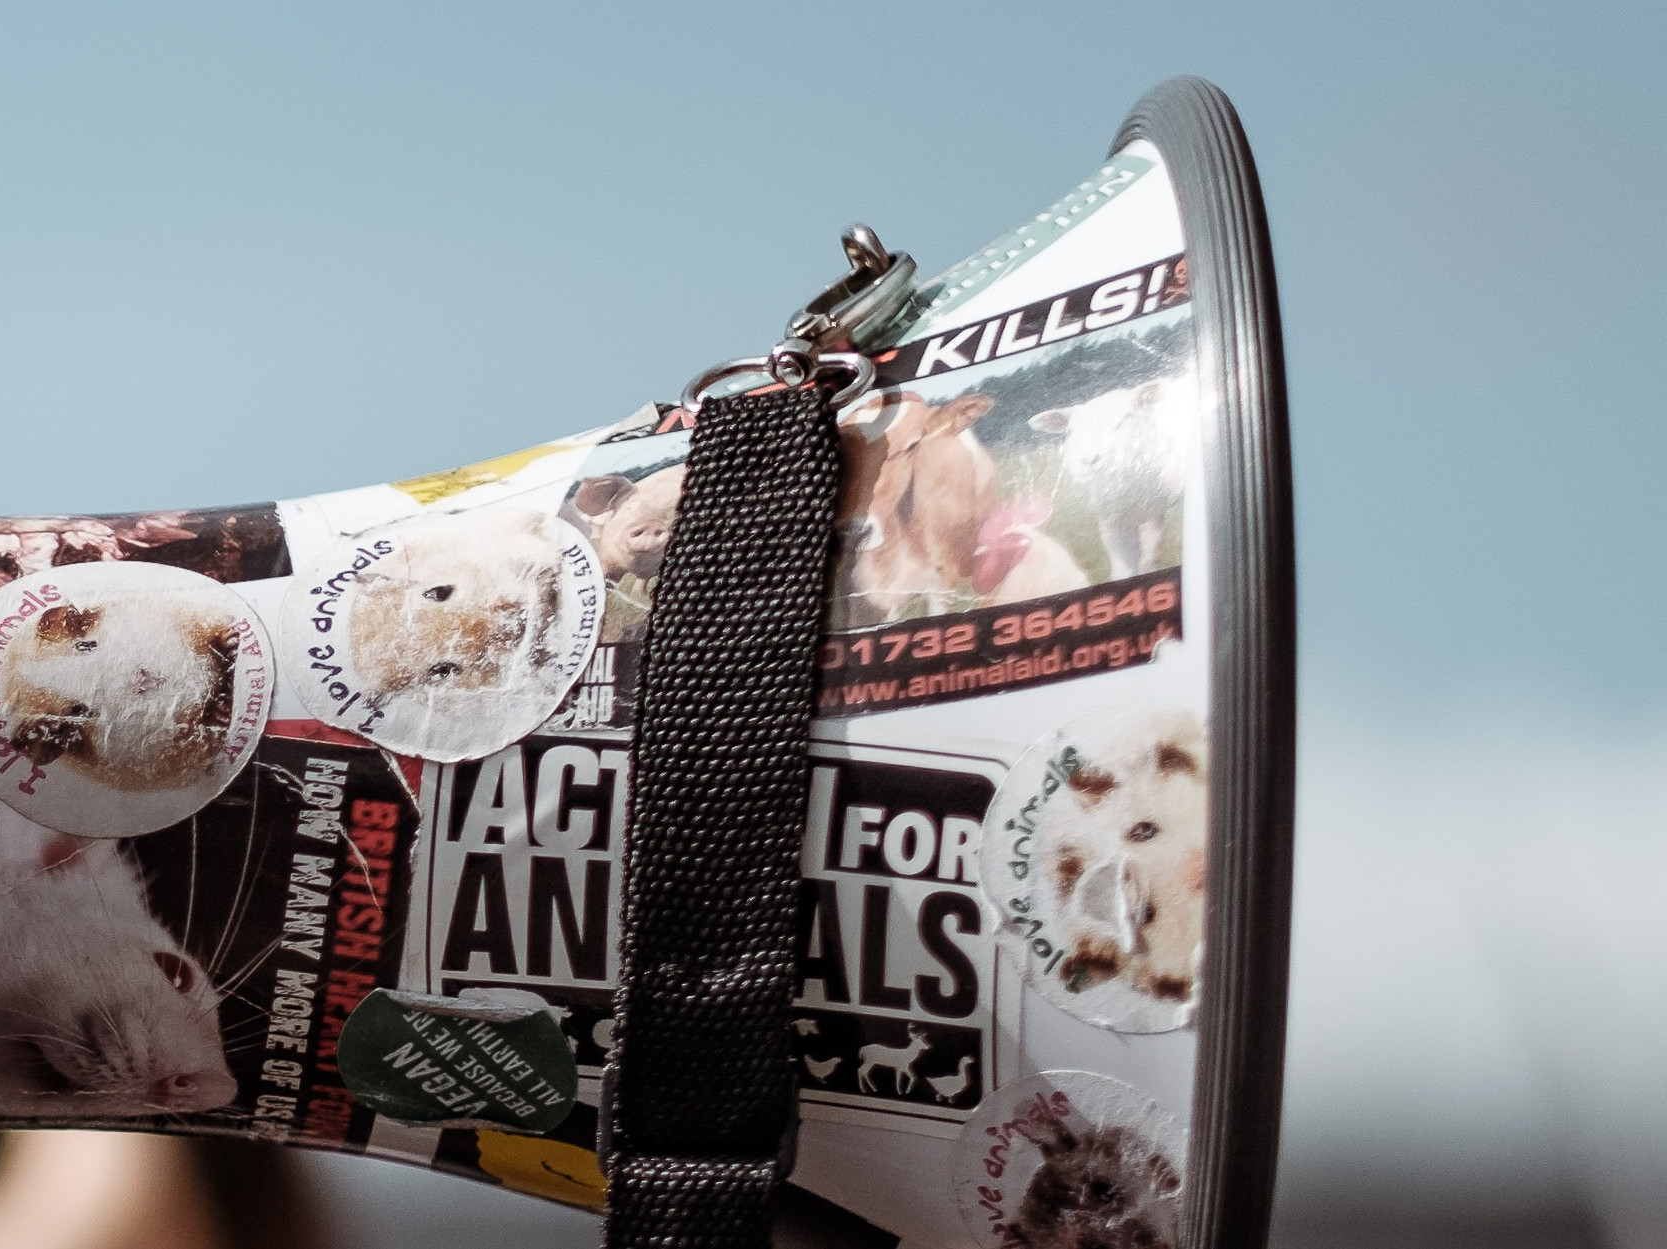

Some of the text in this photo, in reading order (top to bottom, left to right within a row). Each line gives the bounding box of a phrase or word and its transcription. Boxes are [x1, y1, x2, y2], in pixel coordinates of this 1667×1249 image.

[915, 264, 1167, 378] KILLS!
[310, 540, 395, 633] animals
[820, 581, 1176, 669] 01732 364546
[307, 644, 362, 717] love
[18, 763, 47, 796] I
[297, 757, 349, 844] HOW
[1005, 746, 1081, 881] animals
[332, 799, 399, 960] BRITISH
[840, 805, 982, 881] FOR
[281, 853, 335, 960] MANY
[441, 851, 982, 1019] ANALS
[1009, 898, 1064, 976] love
[267, 969, 318, 1053] MORE
[260, 1059, 303, 1090] OF
[383, 1042, 489, 1118] VEGAN
[454, 1055, 536, 1117] BECAUSE
[529, 1078, 566, 1106] ALL
